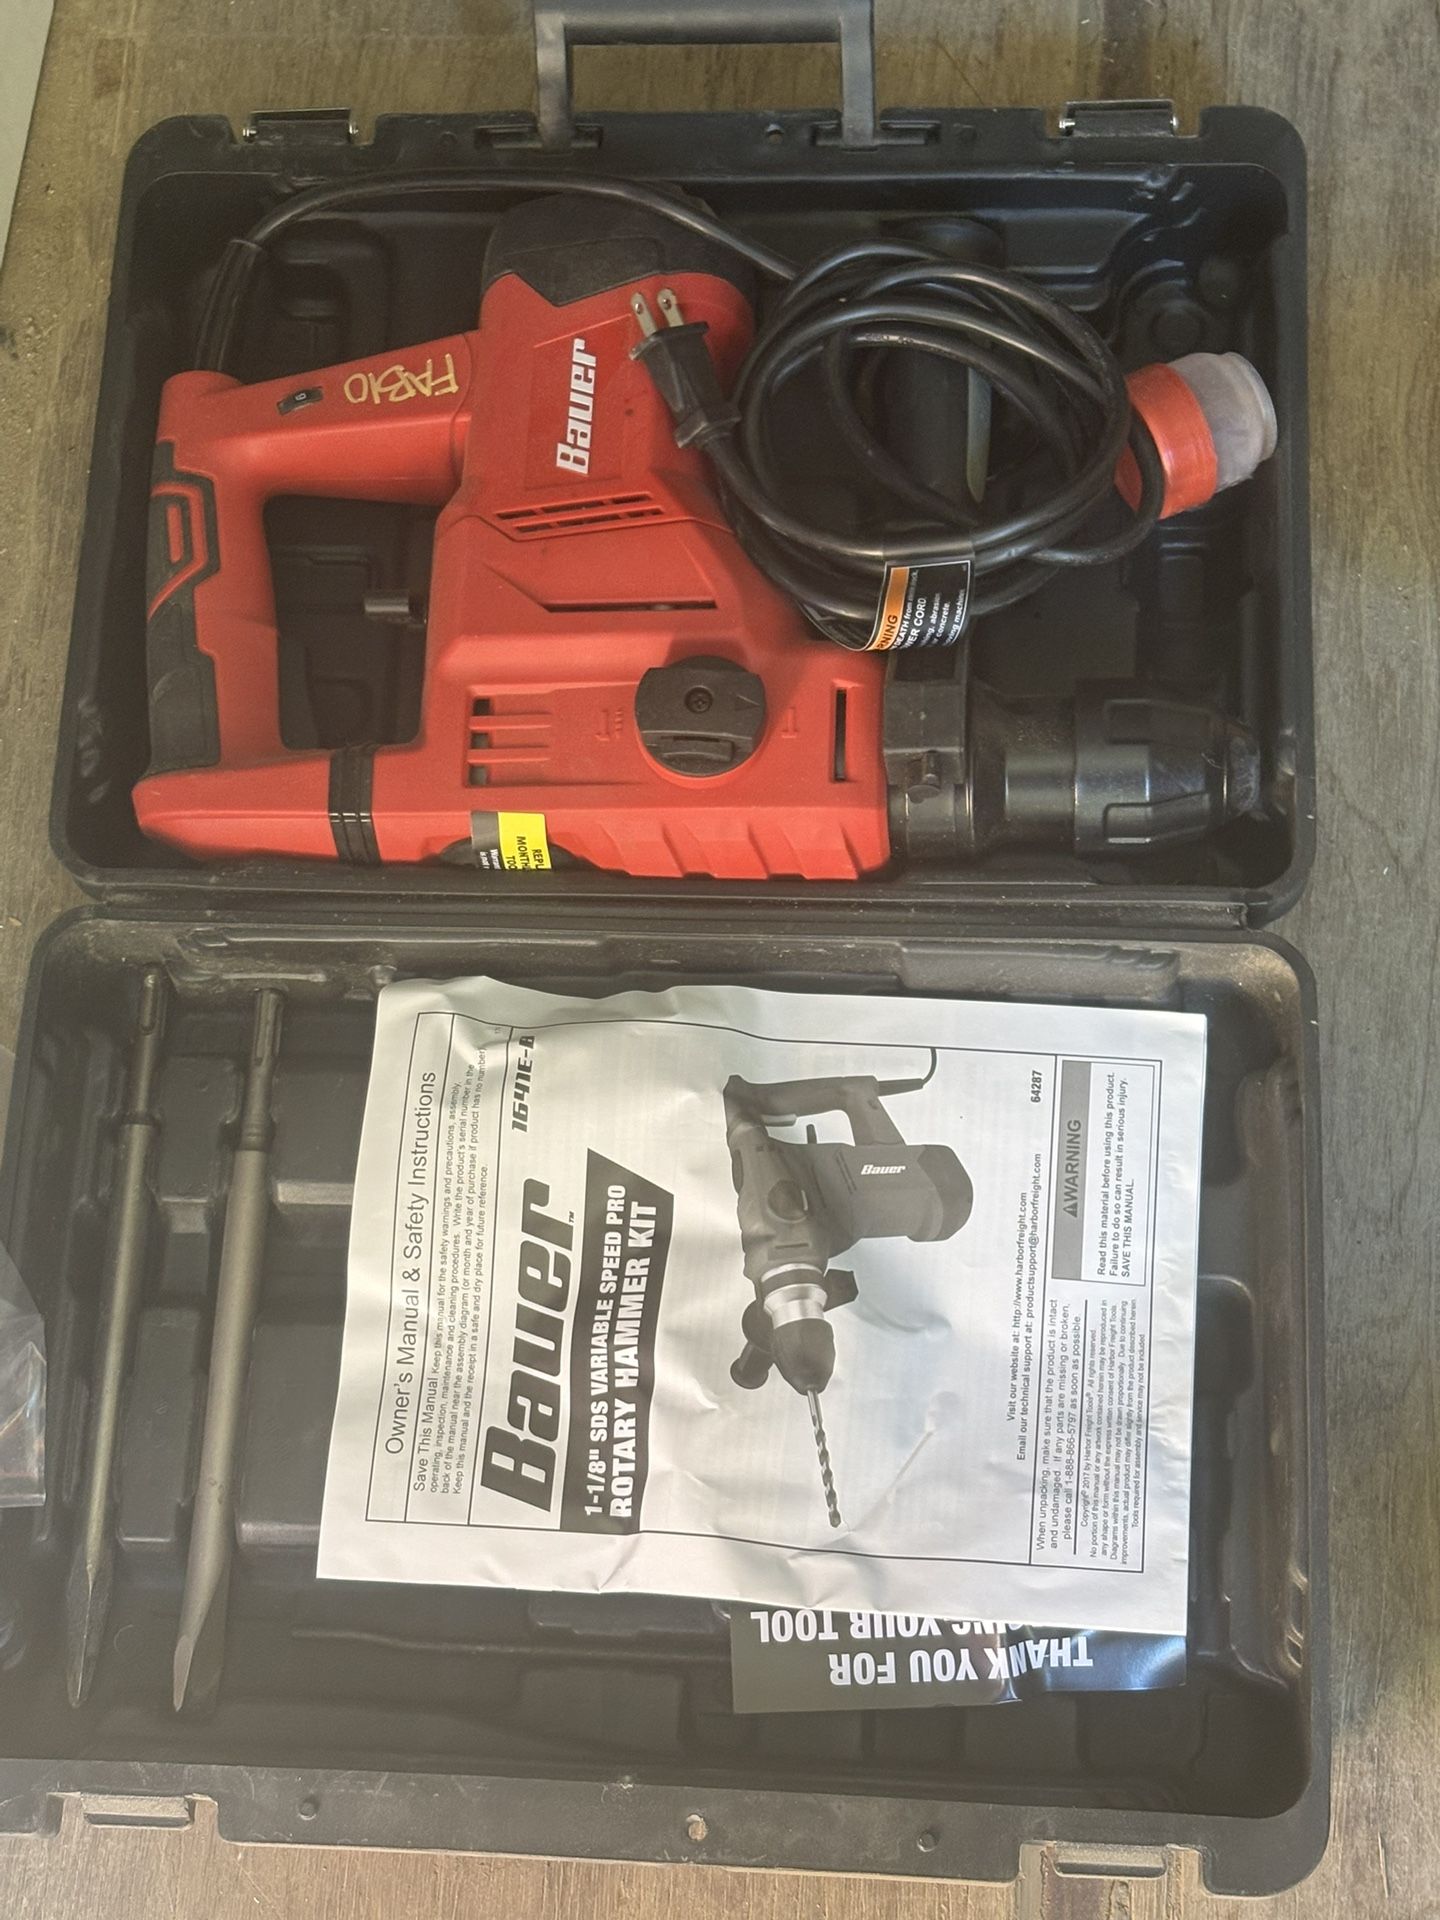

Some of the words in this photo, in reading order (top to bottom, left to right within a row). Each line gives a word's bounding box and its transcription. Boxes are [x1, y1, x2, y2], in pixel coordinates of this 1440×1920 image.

[344, 353, 459, 404] FABIO
[556, 338, 597, 474] Bauer
[463, 1077, 473, 1085] in
[465, 1063, 475, 1077] the
[474, 1082, 483, 1092] no
[1029, 1069, 1043, 1104] 64287
[458, 1086, 472, 1116] number
[471, 1093, 481, 1108] has
[407, 1071, 437, 1186] Instructions
[456, 1117, 467, 1142] serial
[468, 1110, 481, 1144] product
[1103, 1111, 1113, 1128] this
[1115, 1106, 1125, 1142] serious
[443, 1121, 457, 1175] precautions,
[1102, 1130, 1114, 1156] using
[1114, 1143, 1123, 1153] in
[454, 1143, 467, 1184] product's
[466, 1152, 478, 1194] purchase
[861, 1164, 906, 1175] Bauer
[1063, 1118, 1081, 1202] WARNING
[1100, 1158, 1111, 1188] before
[1113, 1154, 1123, 1181] result
[442, 1176, 452, 1194] and
[453, 1185, 463, 1201] the
[1113, 1183, 1122, 1201] can
[464, 1194, 474, 1205] of
[605, 1183, 626, 1226] PRO
[1099, 1190, 1109, 1228] material
[1113, 1202, 1121, 1215] so
[401, 1191, 426, 1260] Safety
[439, 1195, 452, 1236] warnings
[452, 1202, 462, 1226] Write
[465, 1206, 475, 1227] year
[475, 1209, 485, 1236] future
[627, 1200, 657, 1249] KIT
[1111, 1216, 1120, 1229] do
[463, 1228, 473, 1246] and
[474, 1237, 484, 1250] for
[1023, 1152, 1043, 1318] productsupport@harborfreight.com
[1098, 1230, 1107, 1248] this
[1110, 1230, 1120, 1241] to
[1122, 1225, 1132, 1248] THIS
[438, 1237, 450, 1265] safety
[461, 1247, 471, 1276] month
[473, 1251, 485, 1276] place
[599, 1231, 623, 1294] SPEED
[1011, 1191, 1029, 1328] http://www.harborfreight.com
[1096, 1249, 1106, 1275] Read
[1108, 1242, 1119, 1276] Failure
[1120, 1250, 1131, 1277] SAVE
[401, 1265, 420, 1282] &
[437, 1266, 446, 1282] the
[460, 1277, 471, 1290] (or
[472, 1277, 483, 1292] dry
[436, 1282, 446, 1296] for
[434, 1297, 445, 1331] manual
[446, 1285, 459, 1323] cleaning
[458, 1291, 471, 1329] diagram
[470, 1294, 481, 1311] and
[1047, 1298, 1057, 1326] intact
[395, 1288, 420, 1365] Manual
[445, 1324, 455, 1341] and
[469, 1313, 480, 1333] safe
[613, 1255, 651, 1389] HAMMER
[1023, 1320, 1033, 1333] at:
[1047, 1328, 1056, 1337] is
[432, 1332, 443, 1349] this
[467, 1342, 477, 1351] in
[480, 1178, 574, 1513] Bauer
[590, 1297, 614, 1396] VARIABLE
[1011, 1329, 1020, 1343] at:
[1059, 1341, 1068, 1352] or
[430, 1349, 442, 1374] Keep
[454, 1329, 468, 1373] assembly
[1009, 1344, 1019, 1381] website
[1021, 1334, 1033, 1372] support
[1045, 1339, 1057, 1375] product
[1071, 1357, 1079, 1370] as
[439, 1343, 454, 1399] maintenance
[464, 1352, 477, 1383] receipt
[1056, 1353, 1069, 1391] missing
[452, 1373, 462, 1389] the
[463, 1385, 473, 1399] the
[1009, 1382, 1017, 1399] our
[1044, 1377, 1054, 1393] the
[1069, 1371, 1079, 1395] soon
[420, 1376, 439, 1424] Manual
[451, 1389, 461, 1410] near
[1018, 1373, 1030, 1416] technical
[1043, 1394, 1053, 1413] that
[1057, 1392, 1065, 1408] are
[1069, 1397, 1077, 1409] as
[384, 1370, 413, 1455] Owner's
[461, 1400, 472, 1417] and
[589, 1399, 610, 1442] SDS
[1006, 1399, 1016, 1422] Visit
[446, 1410, 458, 1444] manual
[457, 1418, 469, 1451] manual
[1019, 1416, 1028, 1433] our
[1043, 1415, 1052, 1436] sure
[1054, 1410, 1066, 1434] parts
[416, 1426, 432, 1454] This
[444, 1444, 454, 1460] the
[1015, 1434, 1026, 1460] Email
[1040, 1437, 1050, 1464] make
[1054, 1435, 1065, 1453] any
[1063, 1411, 1077, 1485] 1-888-866-5797
[428, 1448, 444, 1493] operating,
[442, 1460, 452, 1470] of
[455, 1452, 465, 1469] this
[609, 1397, 637, 1518] ROTARY
[1052, 1454, 1061, 1462] If
[412, 1457, 429, 1492] Save
[439, 1471, 451, 1494] back
[452, 1470, 465, 1494] Keep
[583, 1447, 607, 1517] 1-1/8"
[1062, 1487, 1073, 1505] call
[1035, 1520, 1046, 1551] When
[1061, 1505, 1073, 1540] please
[1048, 1528, 1058, 1549] and
[750, 1609, 839, 1643] TOOL
[827, 1651, 896, 1686] FOR
[910, 1647, 981, 1683] YOU
[990, 1636, 1094, 1680] THANK
